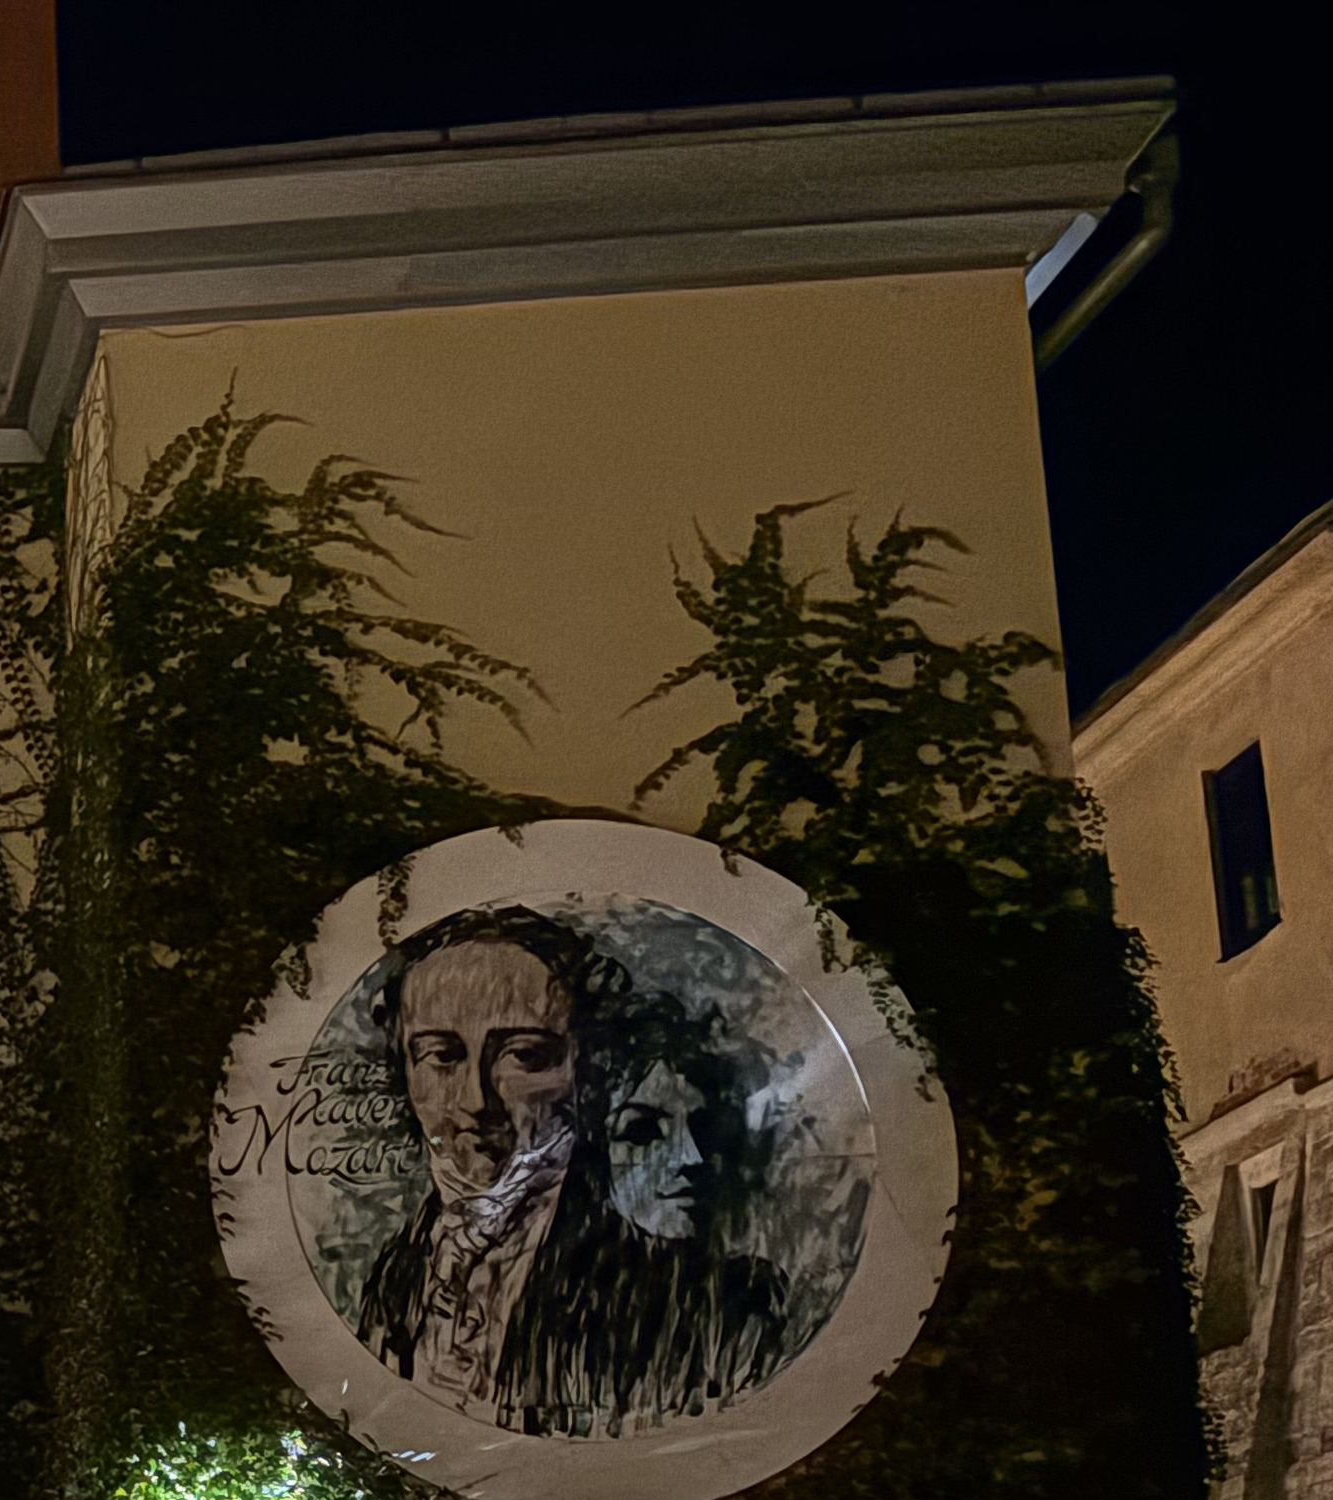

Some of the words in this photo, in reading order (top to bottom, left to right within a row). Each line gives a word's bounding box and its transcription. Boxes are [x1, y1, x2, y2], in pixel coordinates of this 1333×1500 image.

[269, 1051, 389, 1095] Franz
[294, 1088, 405, 1126] Xaver
[218, 1105, 423, 1185] Mozart
